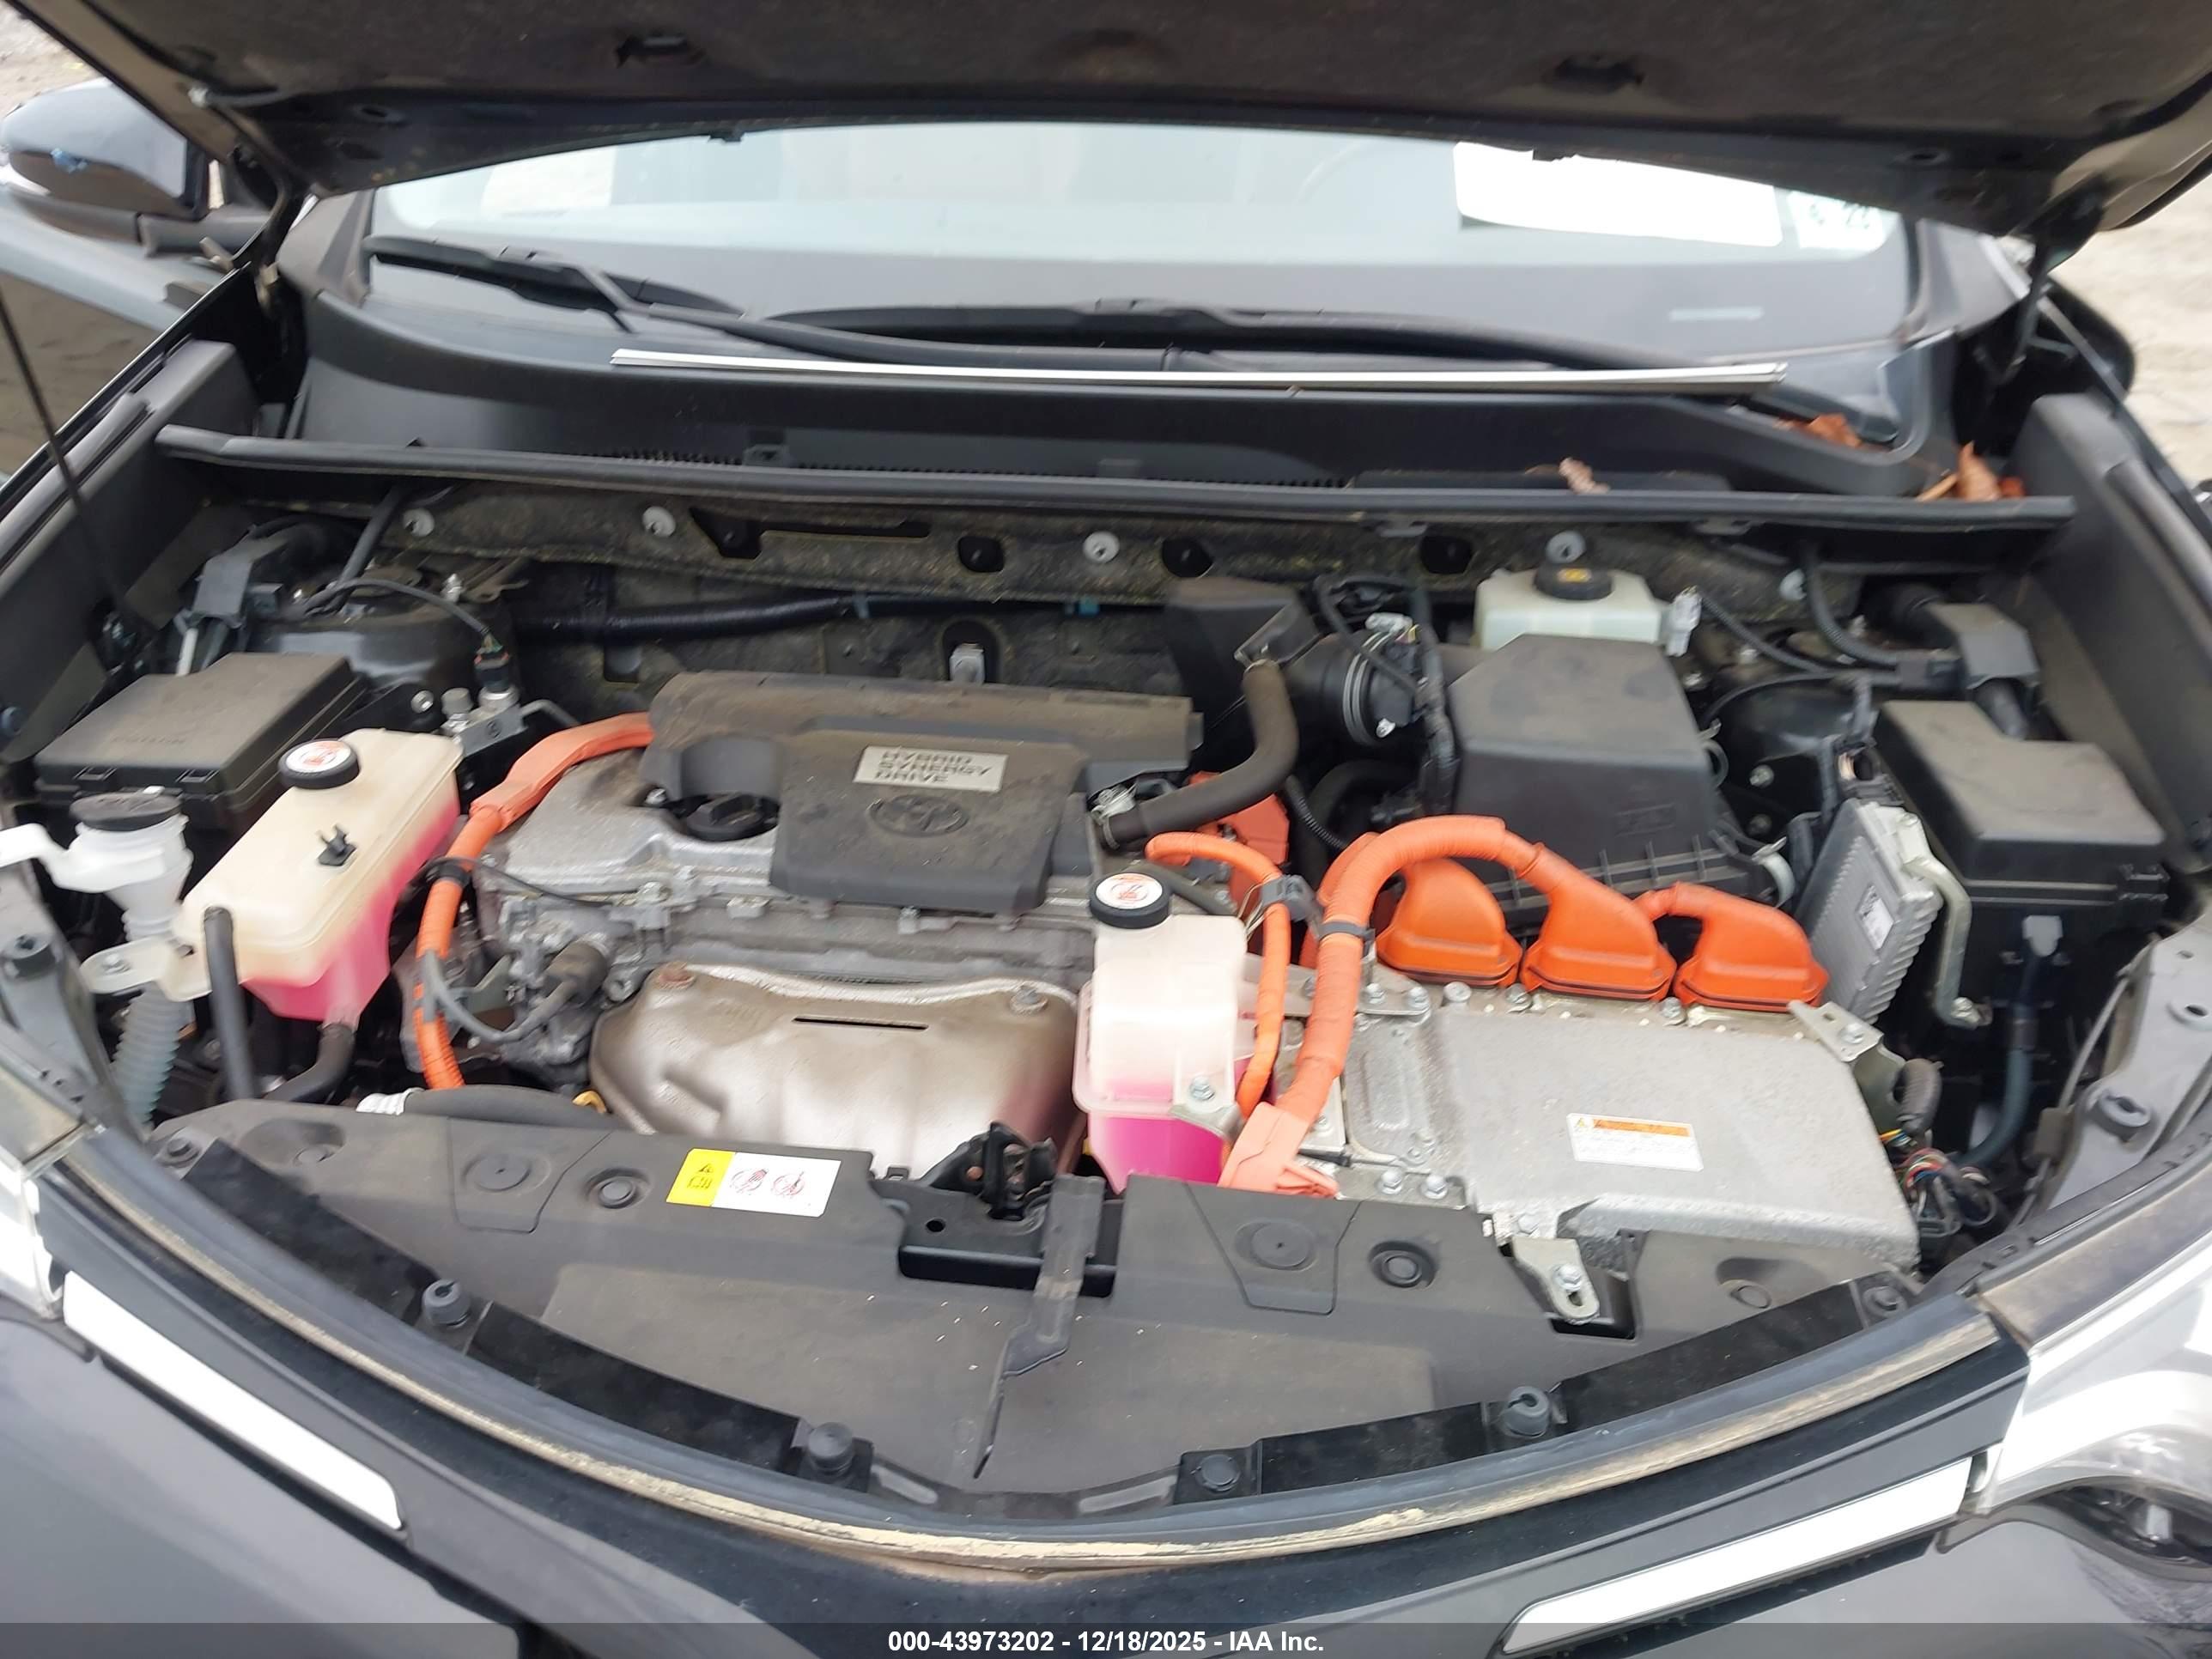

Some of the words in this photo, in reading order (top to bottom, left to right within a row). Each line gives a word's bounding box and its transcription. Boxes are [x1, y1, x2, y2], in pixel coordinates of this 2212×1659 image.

[881, 750, 973, 764] HYBRID
[878, 760, 992, 776] SYNERGY
[874, 770, 949, 783] DRIVE
